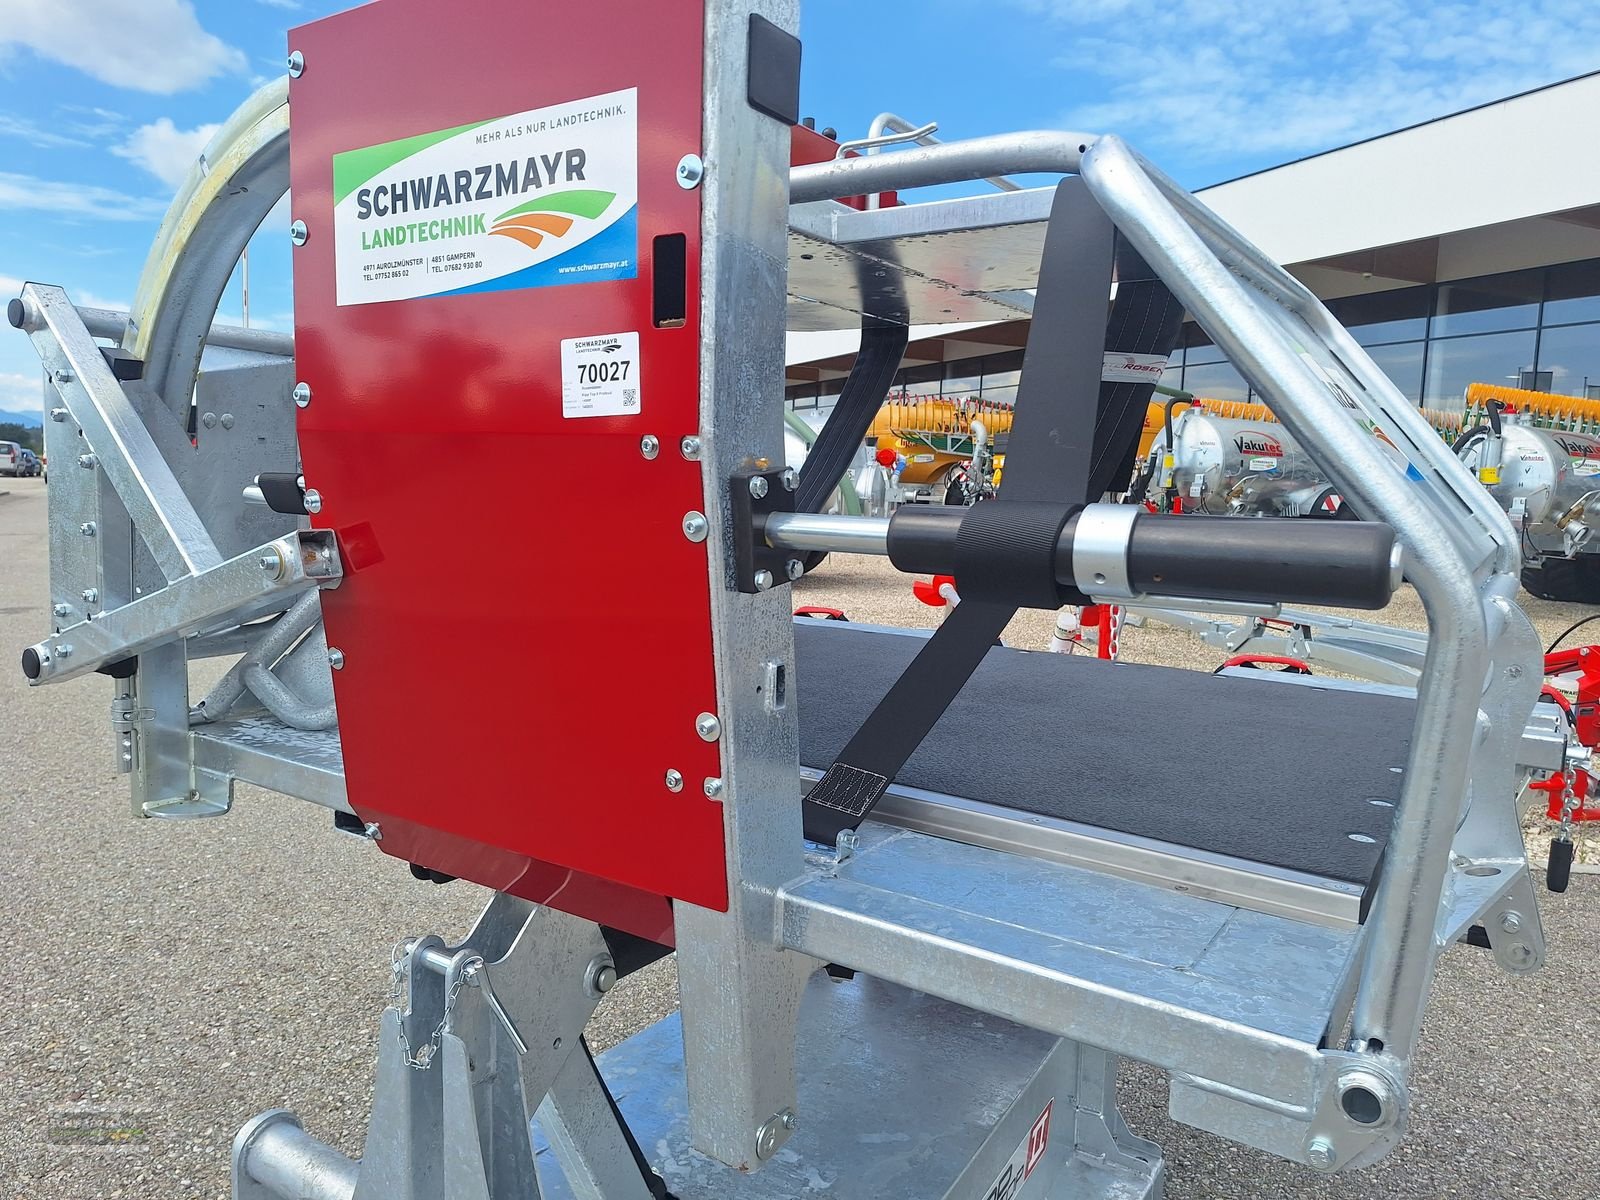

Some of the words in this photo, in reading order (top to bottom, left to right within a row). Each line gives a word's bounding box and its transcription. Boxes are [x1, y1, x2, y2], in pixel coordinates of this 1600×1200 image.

[475, 131, 501, 144] MEHR
[505, 126, 523, 139] ALS
[526, 121, 546, 134] NUR
[550, 104, 626, 129] LANDTECHNIK.
[357, 148, 586, 220] SCHWARZMAYR
[362, 212, 486, 250] LANDTECHNIK
[446, 251, 476, 262] GAMPERN
[363, 264, 376, 272] 4971
[376, 257, 424, 270] AUROLZMÜNSTER
[444, 263, 462, 272] 07682
[462, 262, 474, 270] 930
[475, 260, 483, 269] 80
[558, 260, 628, 274] www.schwarzmayr.at
[374, 272, 391, 280] 07752
[402, 269, 409, 277] 02
[575, 338, 618, 349] SCHWARZMAYR
[577, 360, 631, 384] 70027
[1233, 436, 1283, 455] Vakutec
